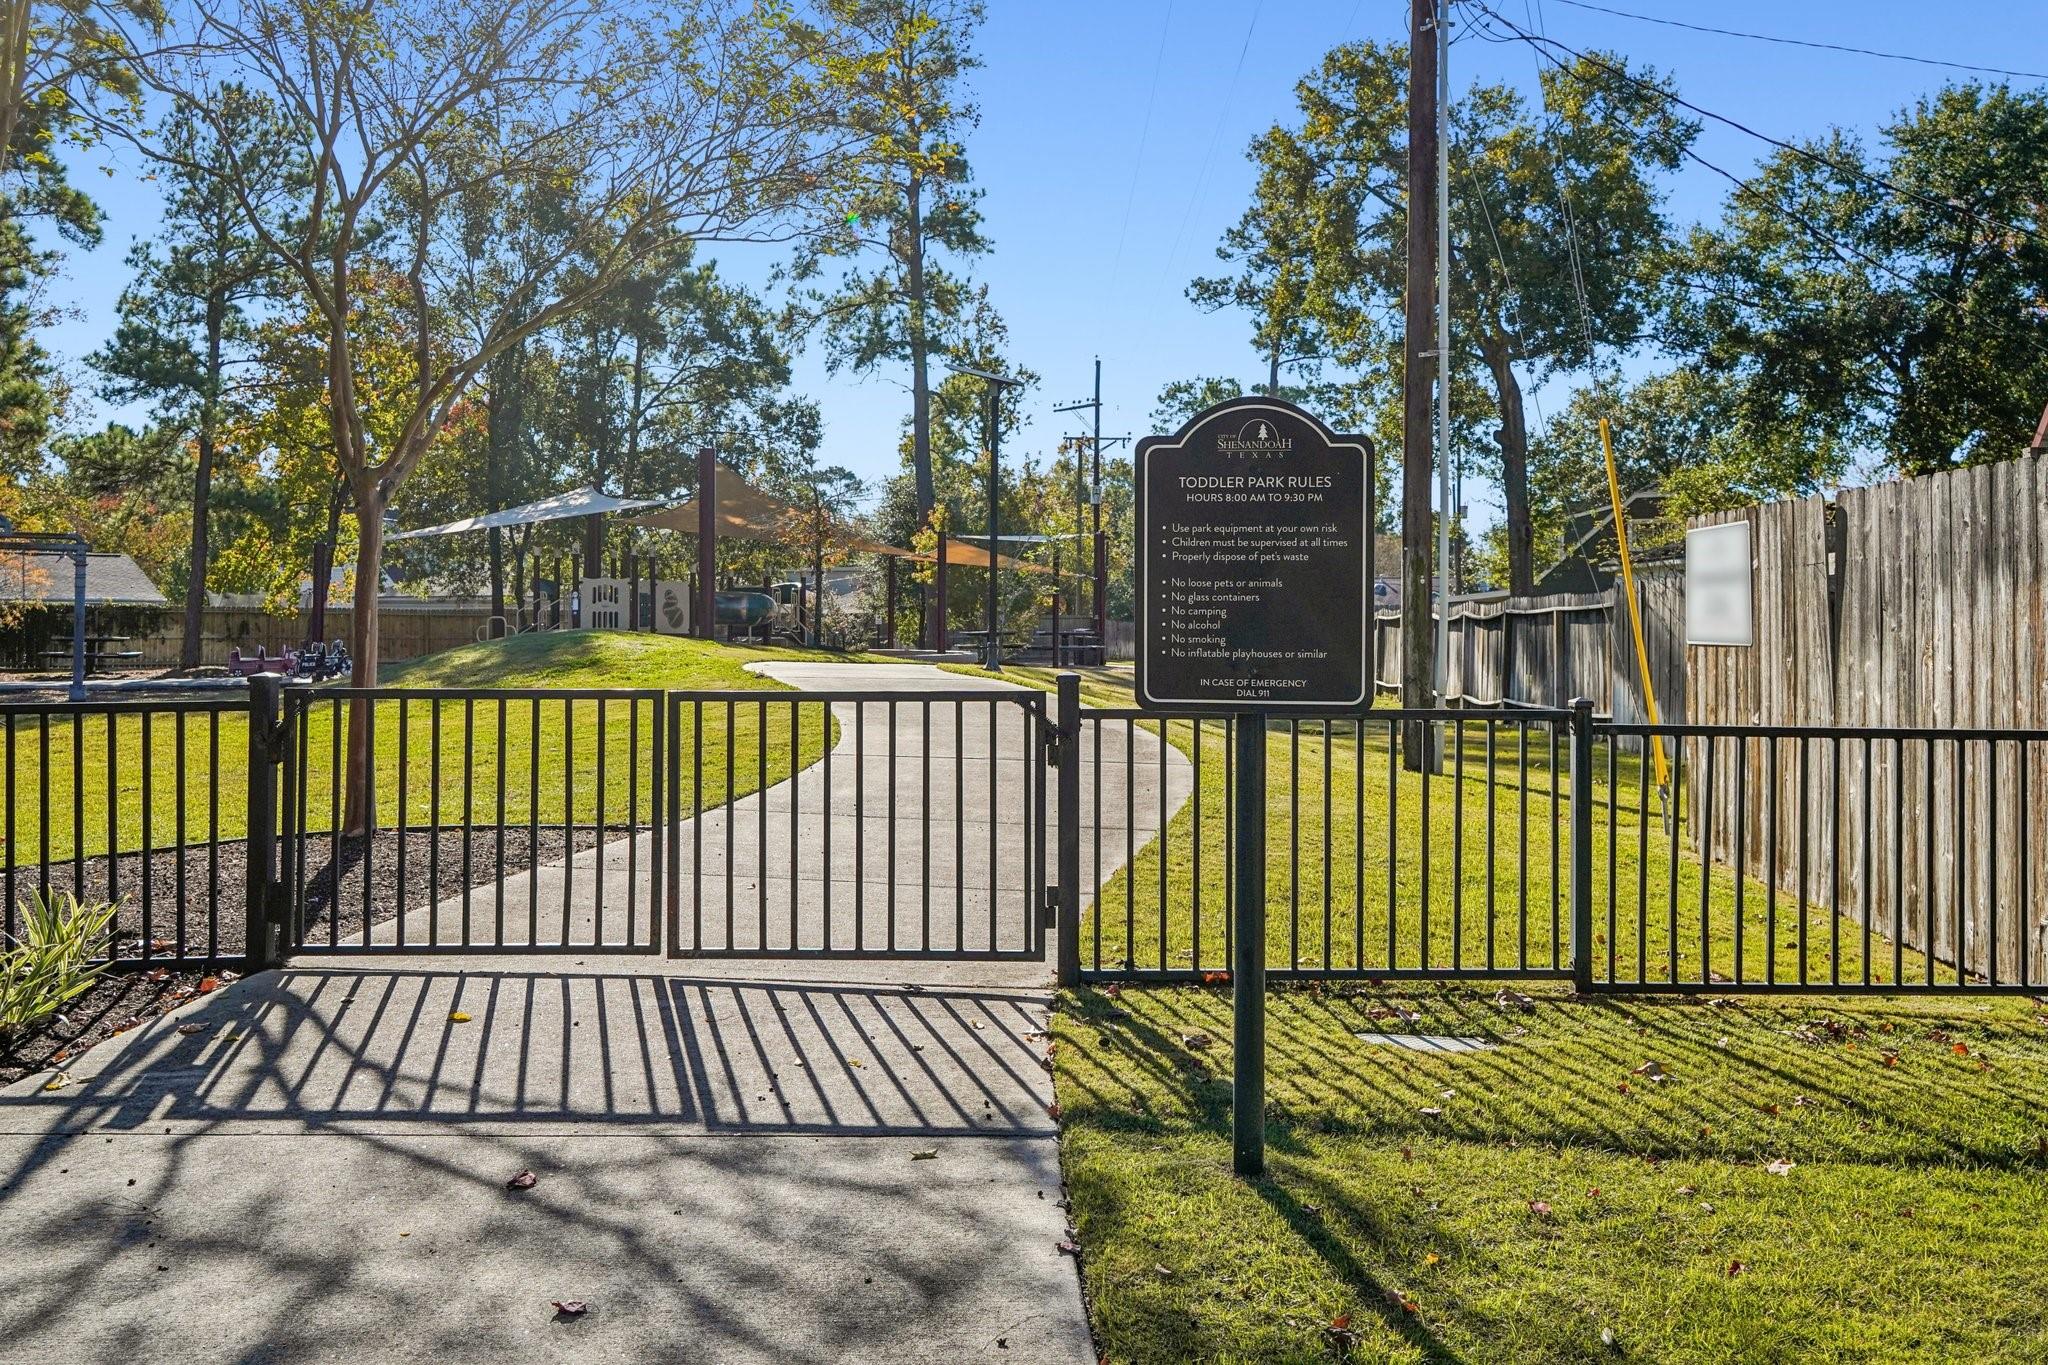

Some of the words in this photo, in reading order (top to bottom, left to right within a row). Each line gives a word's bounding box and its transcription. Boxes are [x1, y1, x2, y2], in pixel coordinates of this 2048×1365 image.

[1217, 438, 1292, 449] SHENANDOAH
[1179, 476, 1244, 488] TODDLER
[1248, 476, 1285, 488] PARK
[1288, 476, 1332, 488] RULES
[1186, 493, 1223, 502] HOURS
[1225, 493, 1247, 502] 8:00
[1249, 493, 1266, 502] AM
[1268, 493, 1282, 502] TO
[1284, 493, 1305, 502] 9:30
[1308, 493, 1323, 502] PM
[1172, 523, 1190, 533] Use
[1192, 523, 1212, 537] park
[1214, 523, 1263, 537] equipment
[1265, 525, 1274, 533] at
[1277, 525, 1299, 538] your
[1321, 523, 1338, 533] risk
[1172, 537, 1211, 547] Children
[1213, 539, 1236, 547] must
[1238, 537, 1249, 547] be
[1250, 537, 1297, 550] supervised
[1299, 539, 1308, 547] at
[1310, 537, 1321, 547] all
[1323, 537, 1348, 547] times
[1172, 552, 1211, 564] Properly
[1212, 551, 1247, 564] dispose
[1248, 551, 1259, 561] of
[1260, 552, 1281, 564] pet's
[1283, 553, 1309, 561] waste
[1171, 578, 1186, 587] No
[1188, 578, 1212, 587] loose
[1214, 579, 1234, 590] pets
[1249, 578, 1283, 587] animals
[1171, 592, 1186, 601] No
[1188, 592, 1210, 604] glass
[1212, 592, 1260, 602] containers
[1171, 606, 1186, 616] No
[1188, 607, 1227, 618] camping
[1171, 620, 1186, 630] No
[1188, 620, 1221, 630] alcohol
[1171, 634, 1186, 644] No
[1188, 634, 1226, 647] smoking
[1171, 648, 1186, 657] No
[1188, 648, 1230, 658] inflatable
[1232, 649, 1283, 661] playhouses
[1298, 649, 1328, 659] similar
[1200, 679, 1210, 687] IN
[1212, 679, 1235, 687] CASE
[1236, 679, 1249, 687] OF
[1251, 679, 1307, 688] EMERGENCY
[1237, 689, 1257, 697] DIAL
[1258, 689, 1270, 697] 911
